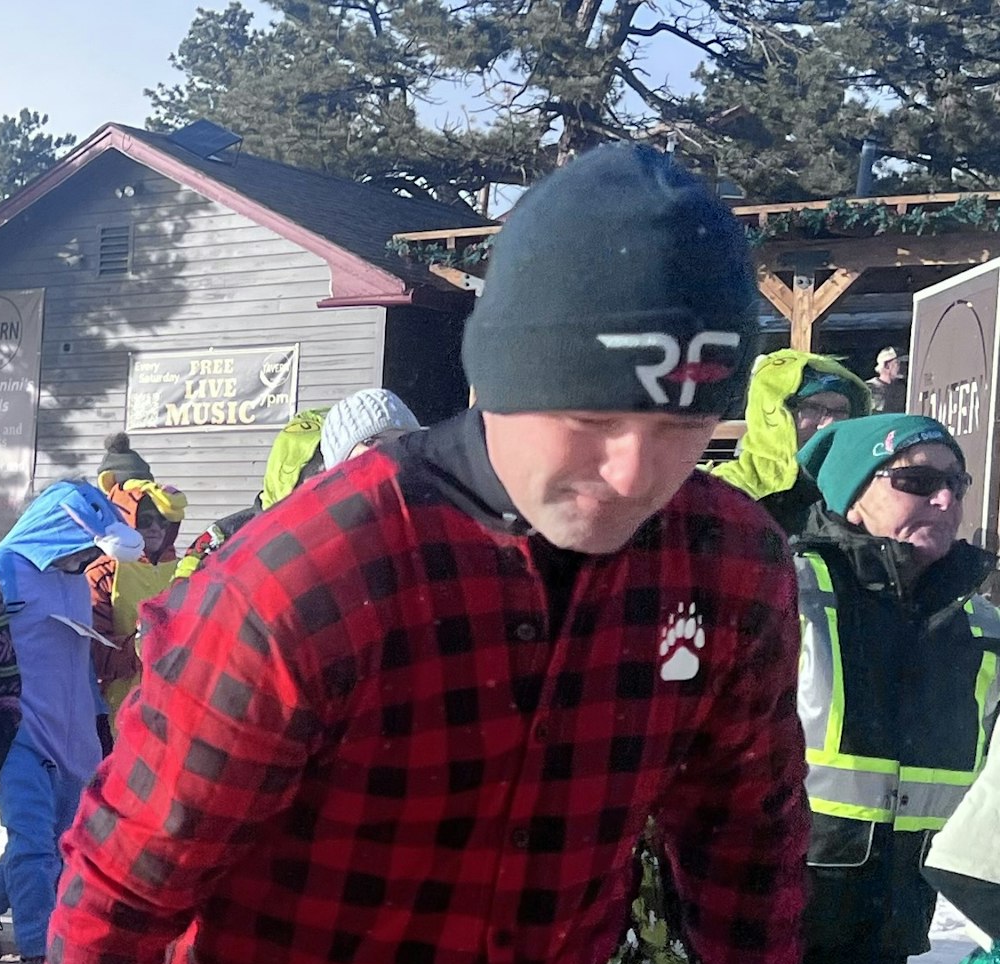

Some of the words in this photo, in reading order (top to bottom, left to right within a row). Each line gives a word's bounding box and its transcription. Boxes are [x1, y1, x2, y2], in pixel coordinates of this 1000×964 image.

[134, 361, 160, 373] Every
[190, 358, 234, 375] FREE
[139, 371, 180, 385] Saturday
[184, 378, 237, 399] LIVE
[165, 400, 256, 427] MUSIC
[3, 422, 23, 435] and
